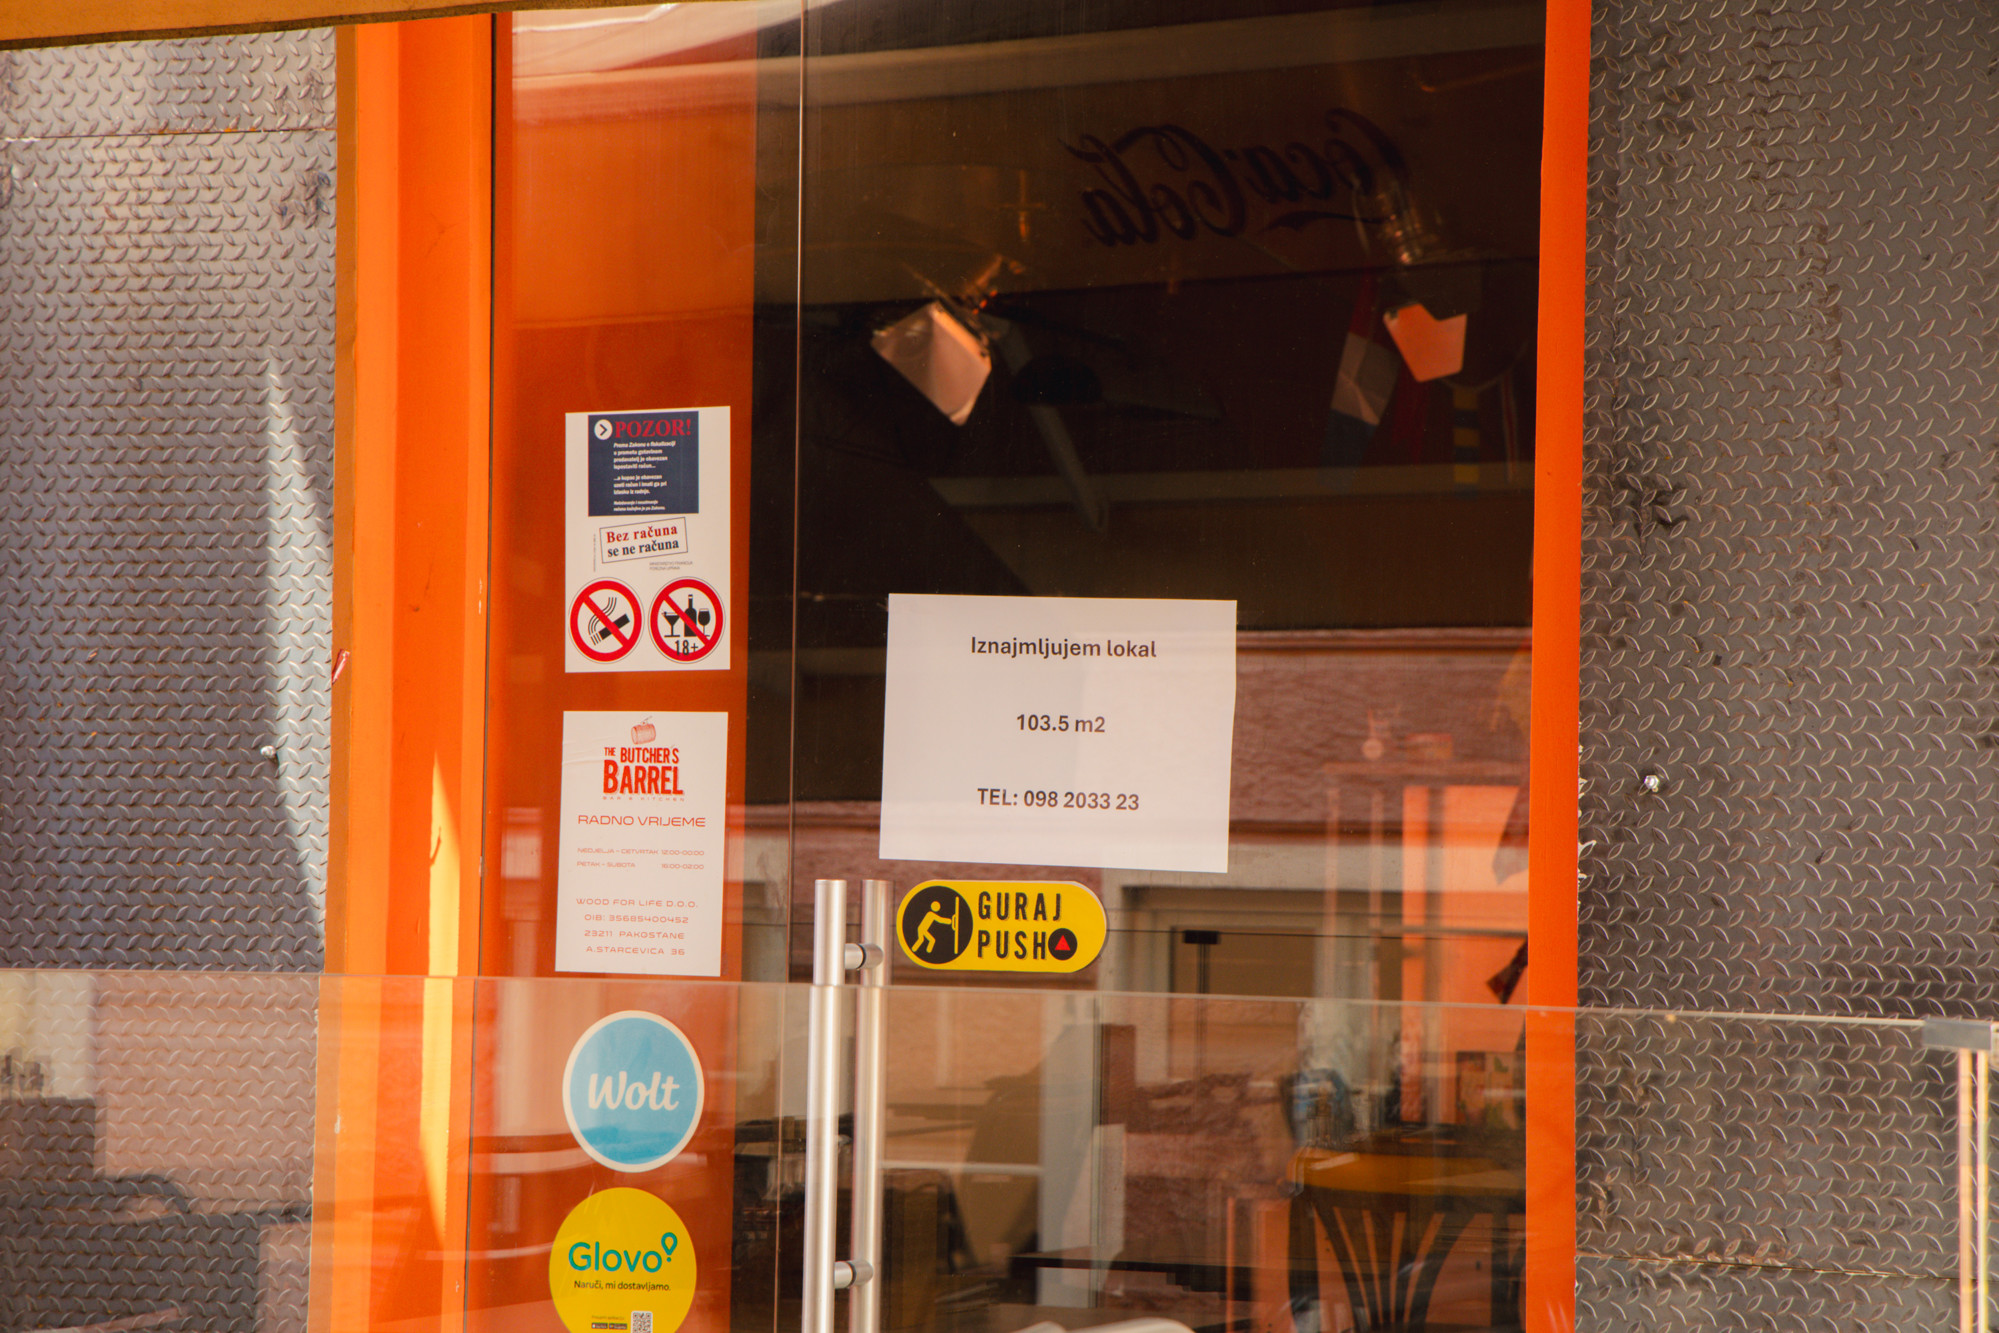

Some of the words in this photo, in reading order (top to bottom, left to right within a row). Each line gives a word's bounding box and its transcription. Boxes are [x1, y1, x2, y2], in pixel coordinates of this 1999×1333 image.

[615, 418, 690, 438] POZOR!
[606, 531, 629, 543] Bez
[634, 526, 677, 540] računa
[608, 547, 619, 557] se
[622, 546, 635, 555] ne
[639, 540, 679, 553] računa
[674, 640, 699, 656] 18+
[971, 637, 1101, 660] Iznajmljujem
[1107, 639, 1157, 658] lokal
[1016, 714, 1069, 732] 103.5
[1075, 716, 1105, 733] m2
[604, 747, 616, 756] THE
[603, 759, 684, 795] BARREL
[977, 788, 1018, 806] TEL:
[1023, 790, 1058, 807] 098
[1063, 792, 1111, 809] 2033
[1116, 793, 1139, 811] 23
[578, 814, 634, 825] RADNO
[638, 816, 705, 827] VRIJEME
[666, 900, 698, 908] D.O.O.
[977, 890, 1061, 921] GURAJ
[609, 915, 689, 923] 35685400452
[619, 931, 684, 939] PAKOSTANE
[586, 946, 664, 955] A.STARCEVICA
[977, 929, 1048, 960] PUSH
[588, 1071, 680, 1111] Wolt
[569, 1242, 662, 1273] Glovo
[574, 1280, 603, 1290] Naruči,
[605, 1281, 616, 1289] mi
[618, 1282, 671, 1291] dostavljamo.
